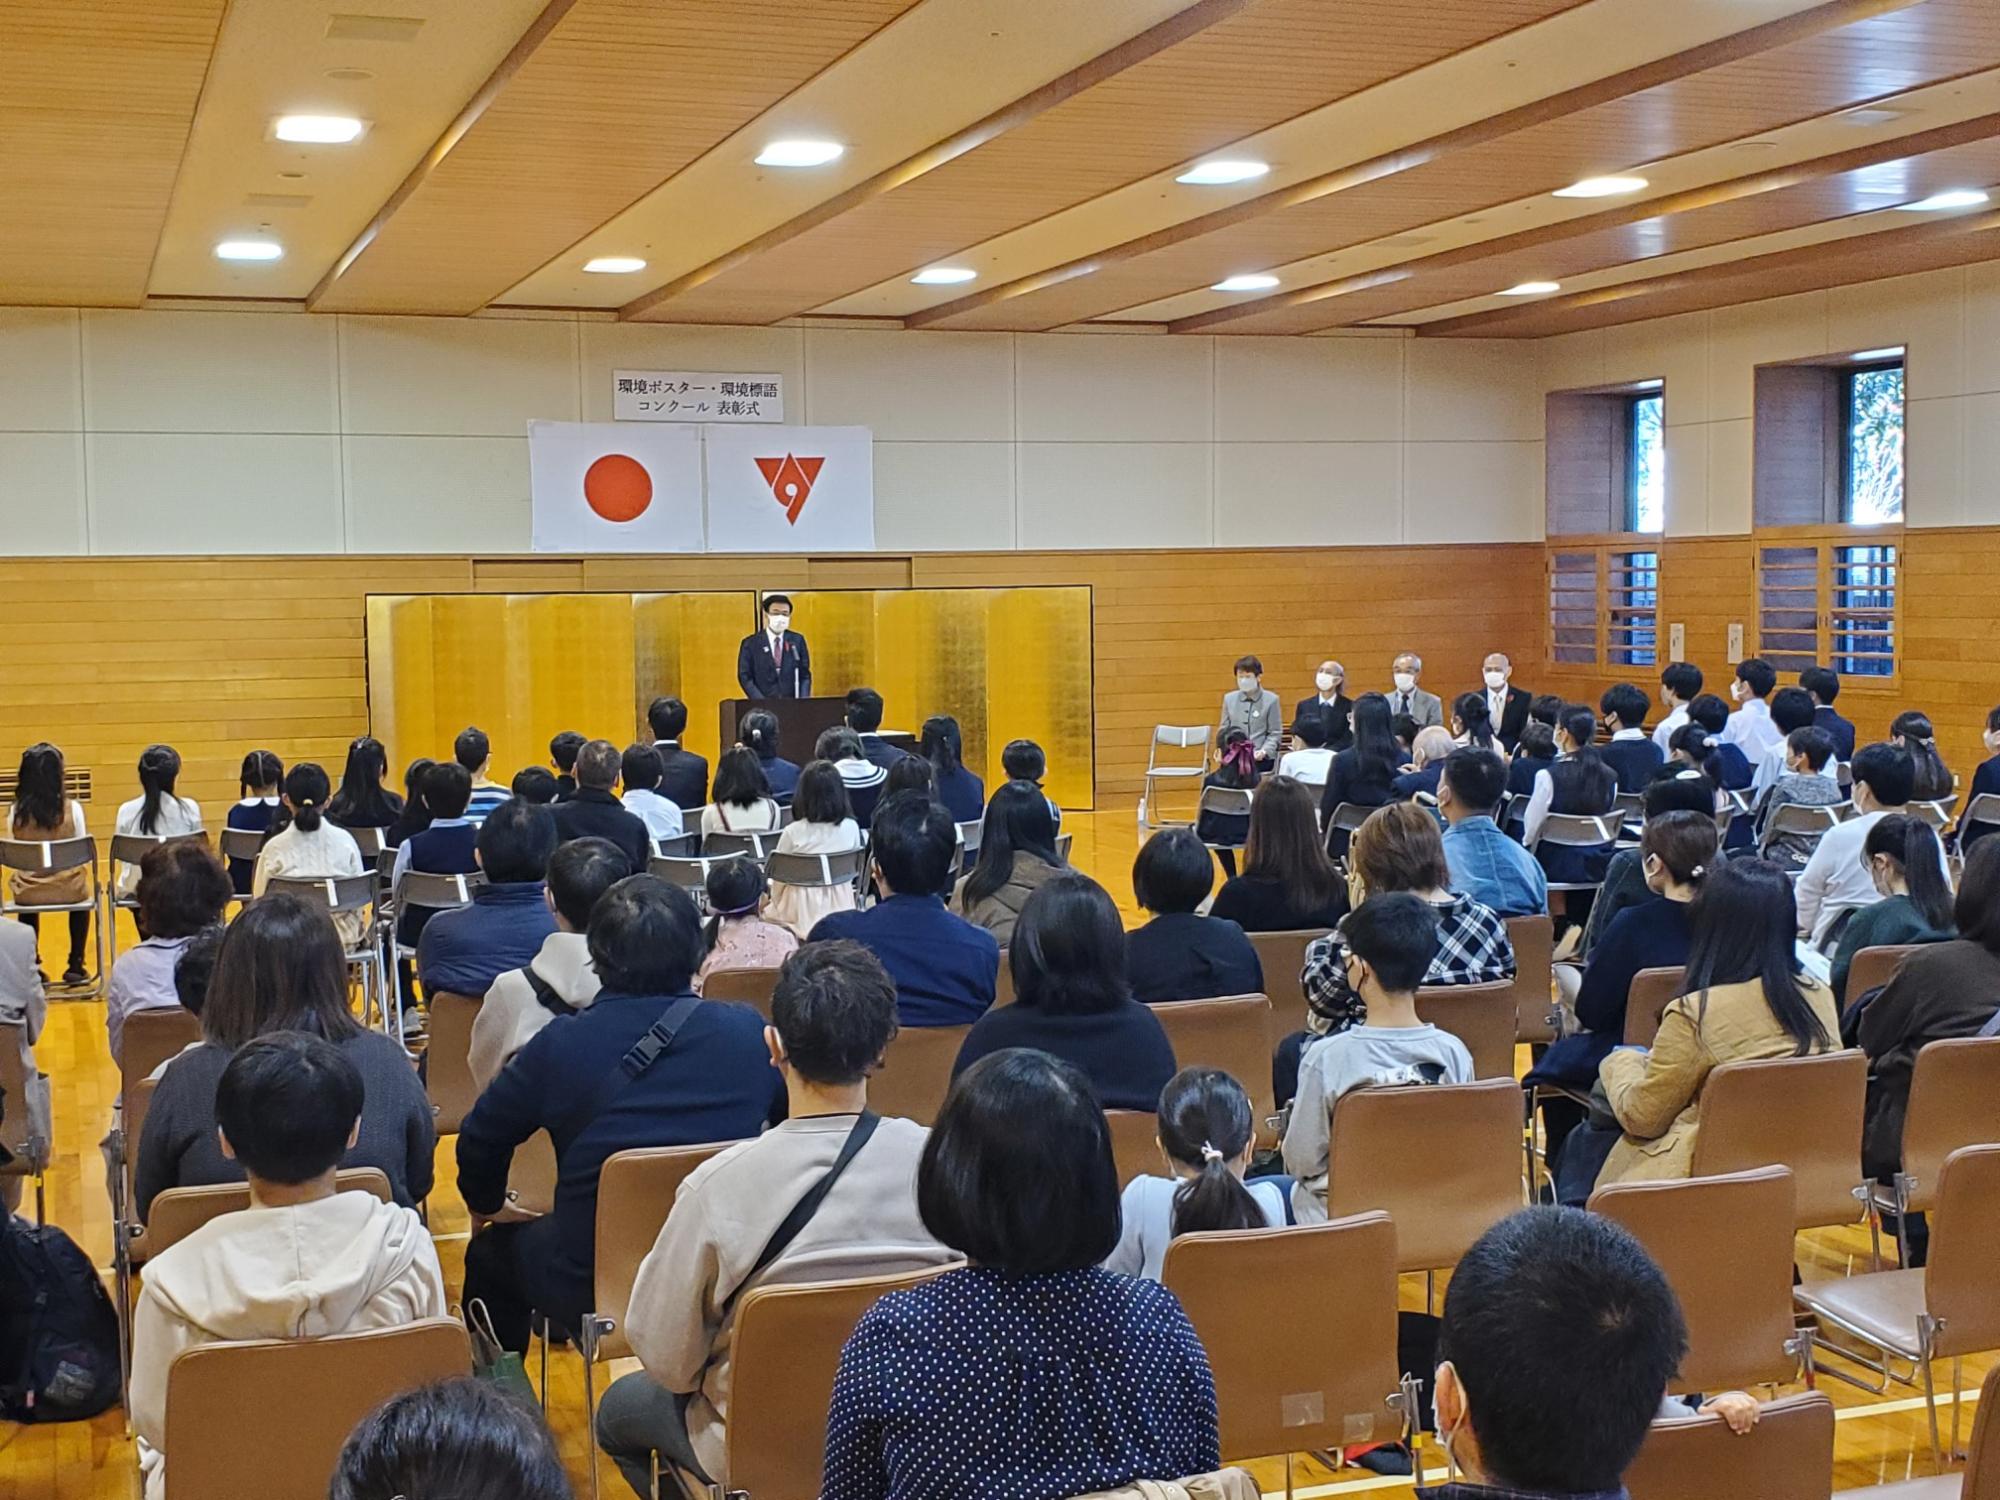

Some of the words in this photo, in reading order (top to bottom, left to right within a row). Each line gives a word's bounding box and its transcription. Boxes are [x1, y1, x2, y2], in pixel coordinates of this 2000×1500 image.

[617, 378, 779, 398] 環境ポスター・環境標語
[638, 400, 710, 413] コンクール
[717, 400, 761, 416] 表彰式
